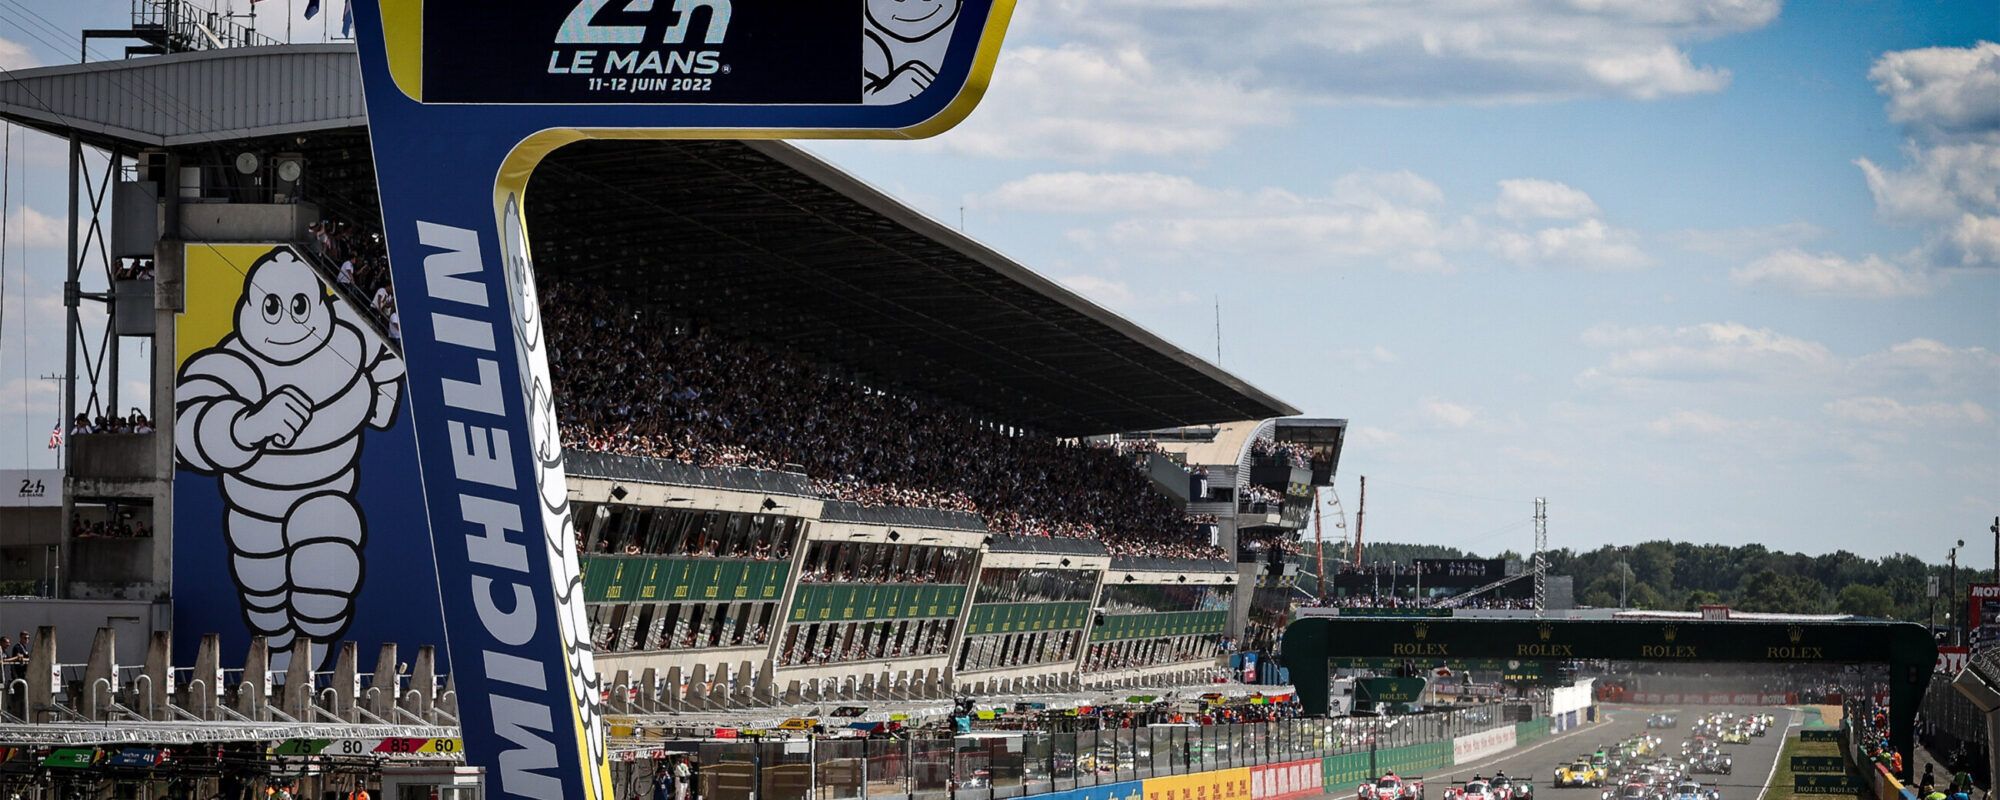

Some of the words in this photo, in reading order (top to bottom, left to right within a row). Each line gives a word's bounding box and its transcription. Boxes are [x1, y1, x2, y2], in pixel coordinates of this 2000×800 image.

[547, 50, 597, 74] LE
[603, 50, 721, 74] MANS
[588, 78, 627, 91] 11-12
[630, 78, 668, 93] JUIN
[671, 78, 712, 92] 2022
[416, 219, 565, 800] MICHELIN
[1393, 643, 1448, 655] ROLEX
[1518, 644, 1573, 657] ROLEX
[1642, 645, 1697, 658] ROLEX
[1767, 647, 1823, 659] ROLEX
[293, 738, 311, 753] 75
[343, 740, 362, 754] 80
[391, 739, 410, 752] 85
[435, 739, 453, 752] 60
[75, 753, 90, 763] 32
[142, 753, 155, 763] 41
[1797, 785, 1826, 793] ROLEX
